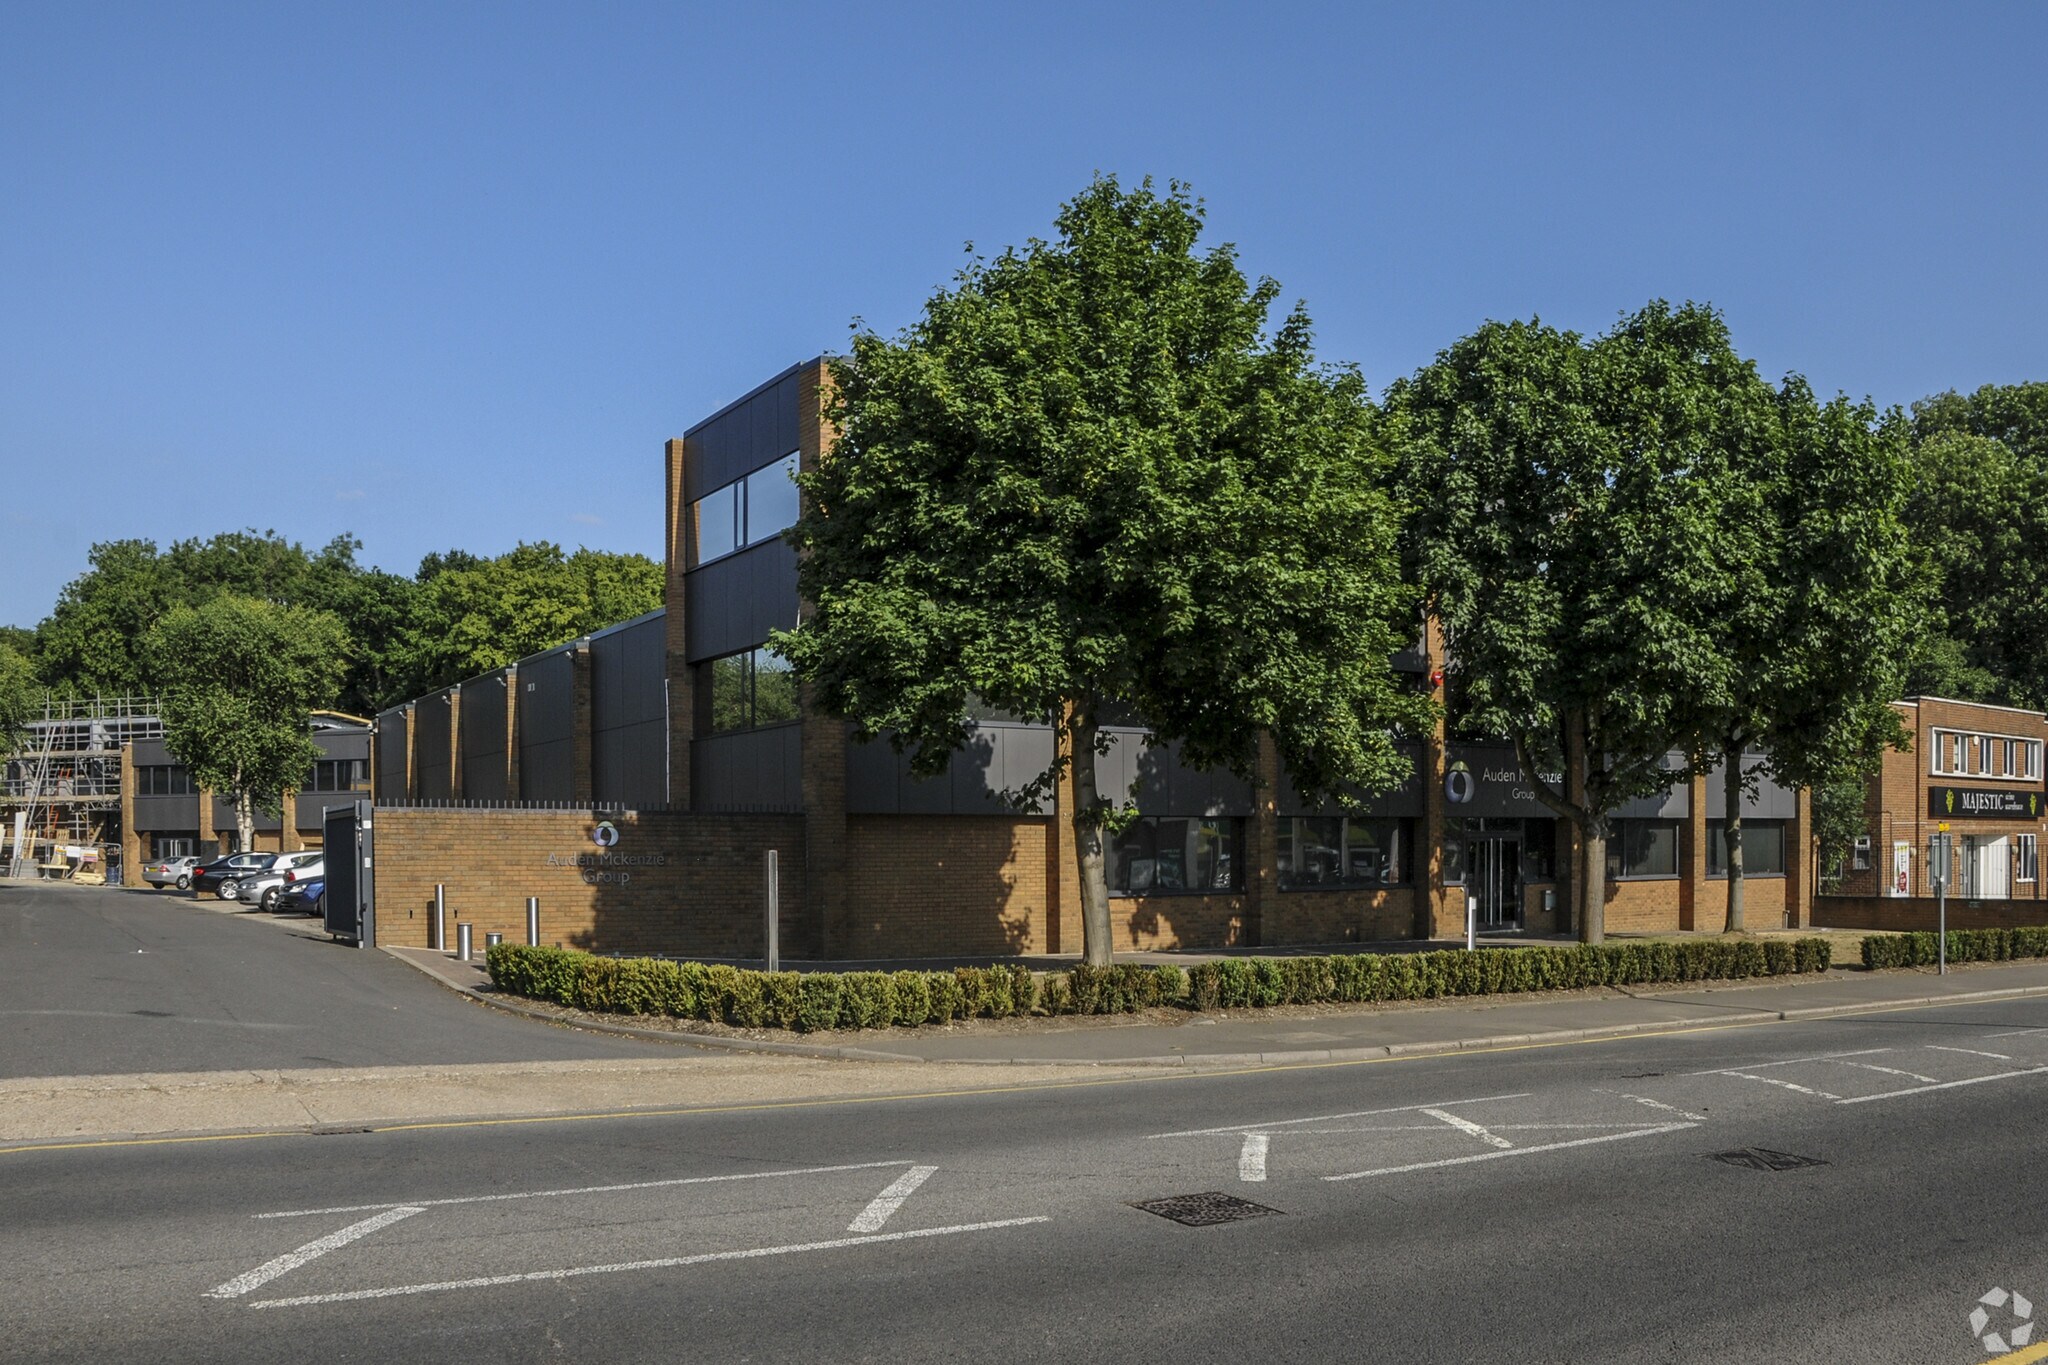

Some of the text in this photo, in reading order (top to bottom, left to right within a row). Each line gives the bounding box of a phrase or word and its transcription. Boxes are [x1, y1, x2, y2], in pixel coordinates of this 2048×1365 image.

[1482, 767, 1516, 782] Auden
[1512, 787, 1535, 801] Group
[1962, 792, 2004, 814] MAJESTIC
[546, 851, 665, 866] Auden Mckenzie
[583, 868, 630, 886] Group
